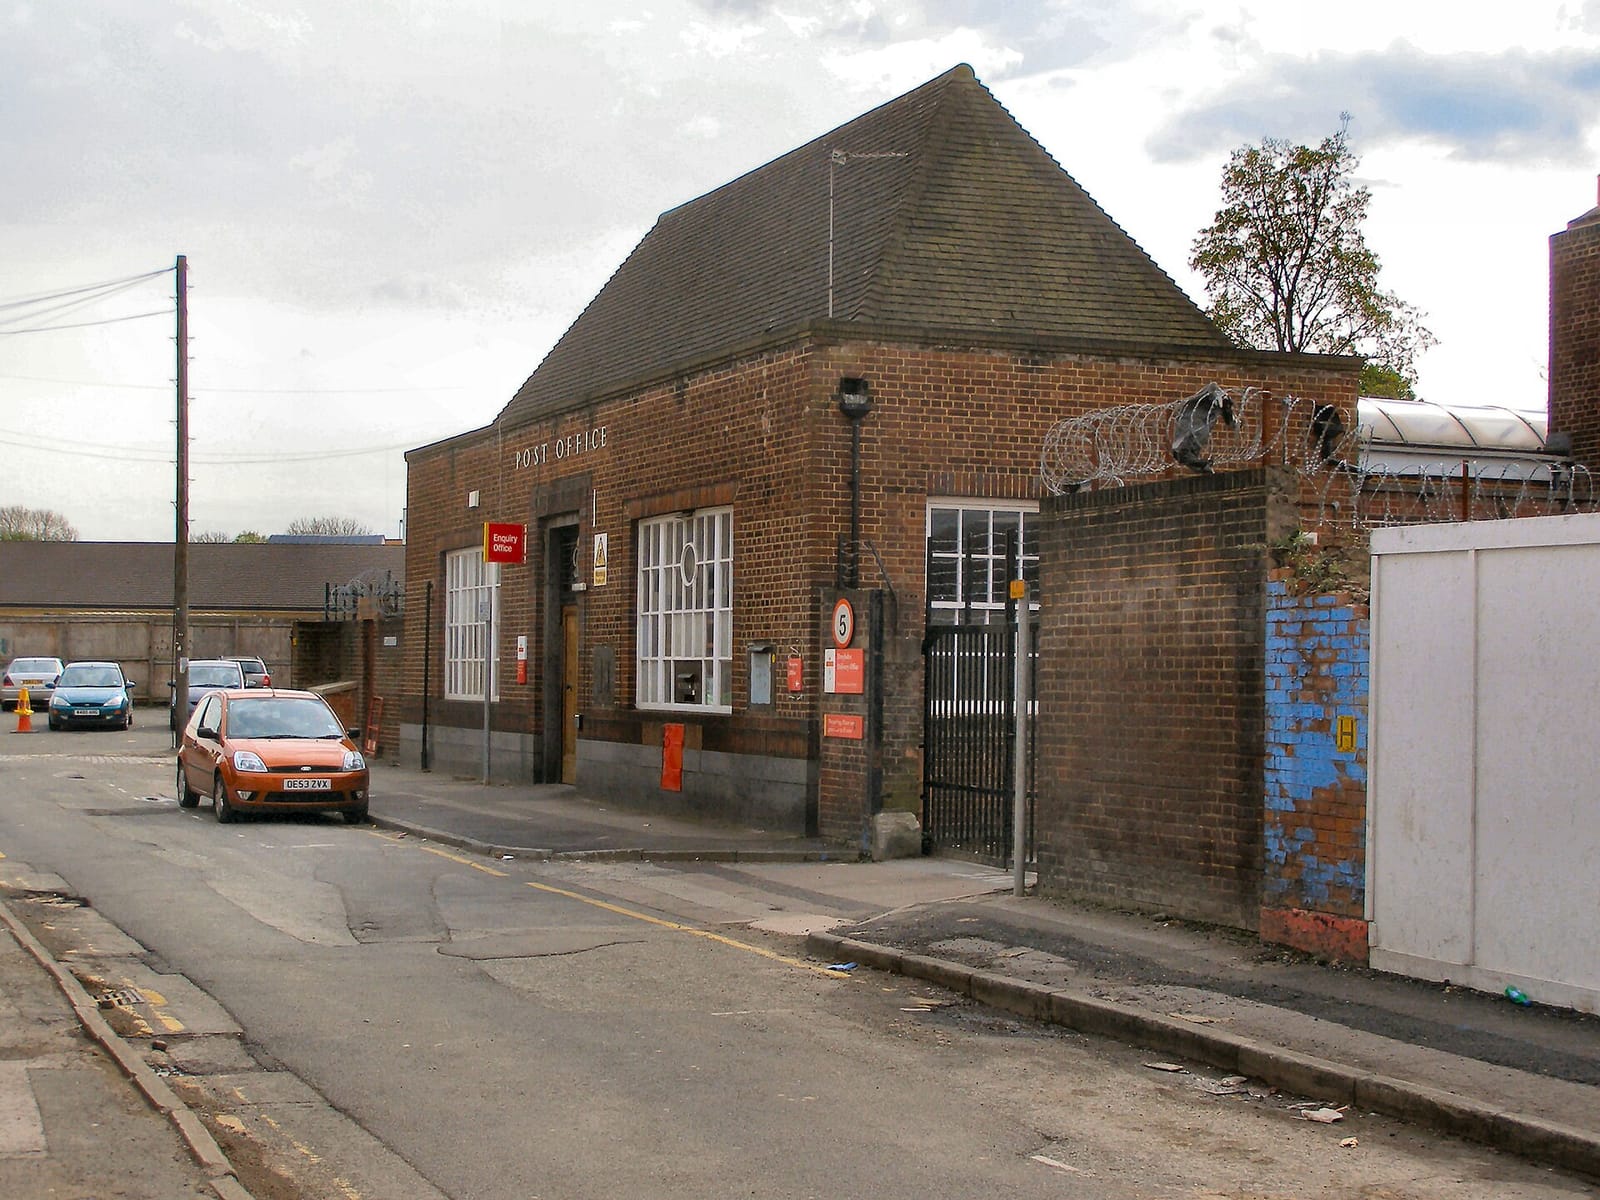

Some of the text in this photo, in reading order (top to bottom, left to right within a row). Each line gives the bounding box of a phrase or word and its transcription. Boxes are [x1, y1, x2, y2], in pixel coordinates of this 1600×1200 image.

[515, 426, 607, 470] POST OFFICE
[493, 533, 518, 544] Enquiry
[493, 543, 513, 552] Office
[839, 614, 847, 636] 5
[311, 780, 328, 788] ZVX
